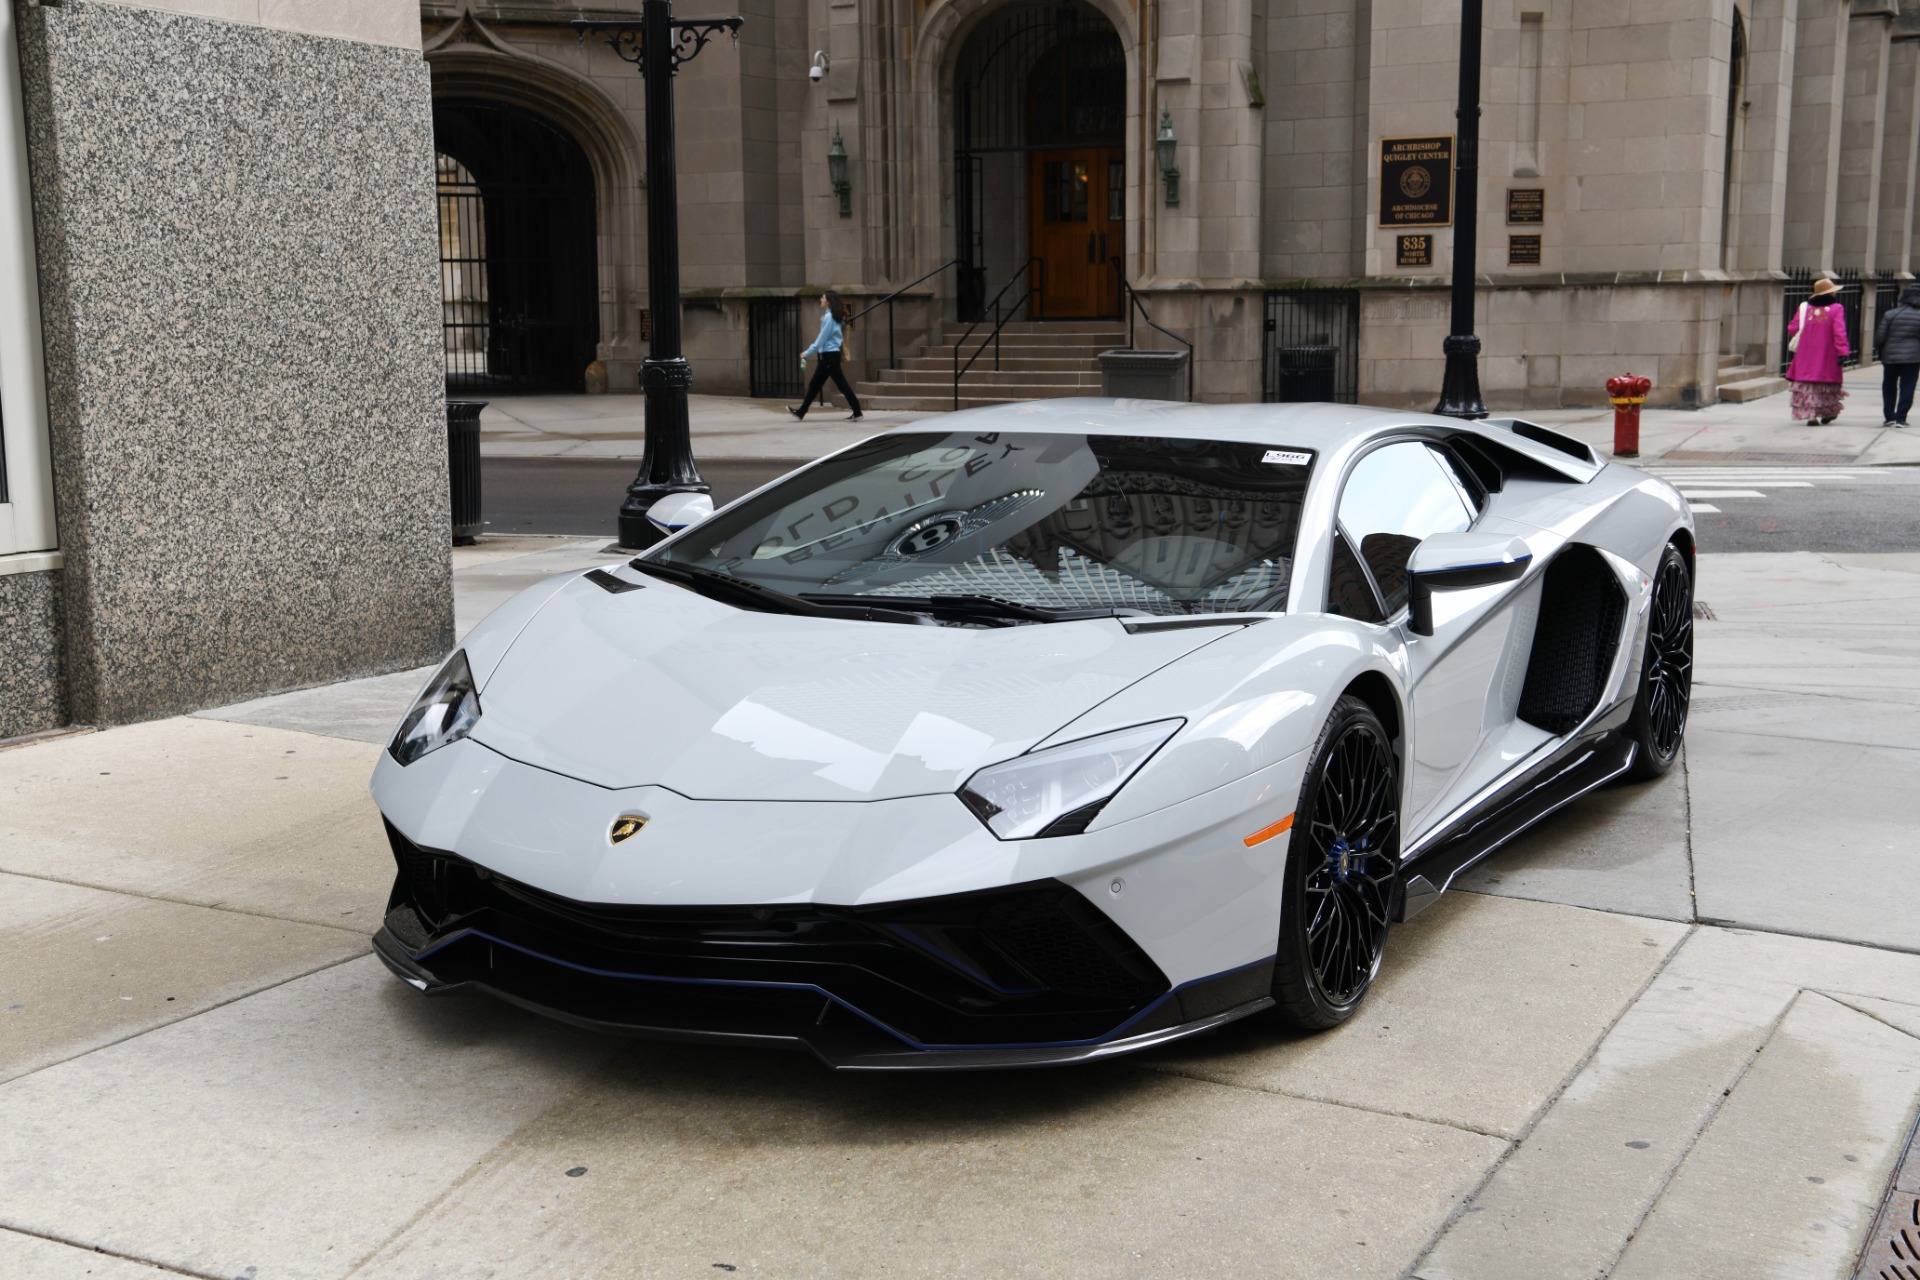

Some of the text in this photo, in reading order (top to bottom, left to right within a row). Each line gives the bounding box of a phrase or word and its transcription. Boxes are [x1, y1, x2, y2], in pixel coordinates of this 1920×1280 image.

[1391, 142, 1442, 152] ARCHBISHOP
[1383, 151, 1450, 163] QUIGLEY CENTER
[1391, 204, 1439, 212] ARCHDIOCESE
[1406, 212, 1435, 220] CHICAGO
[1402, 236, 1426, 250] 835
